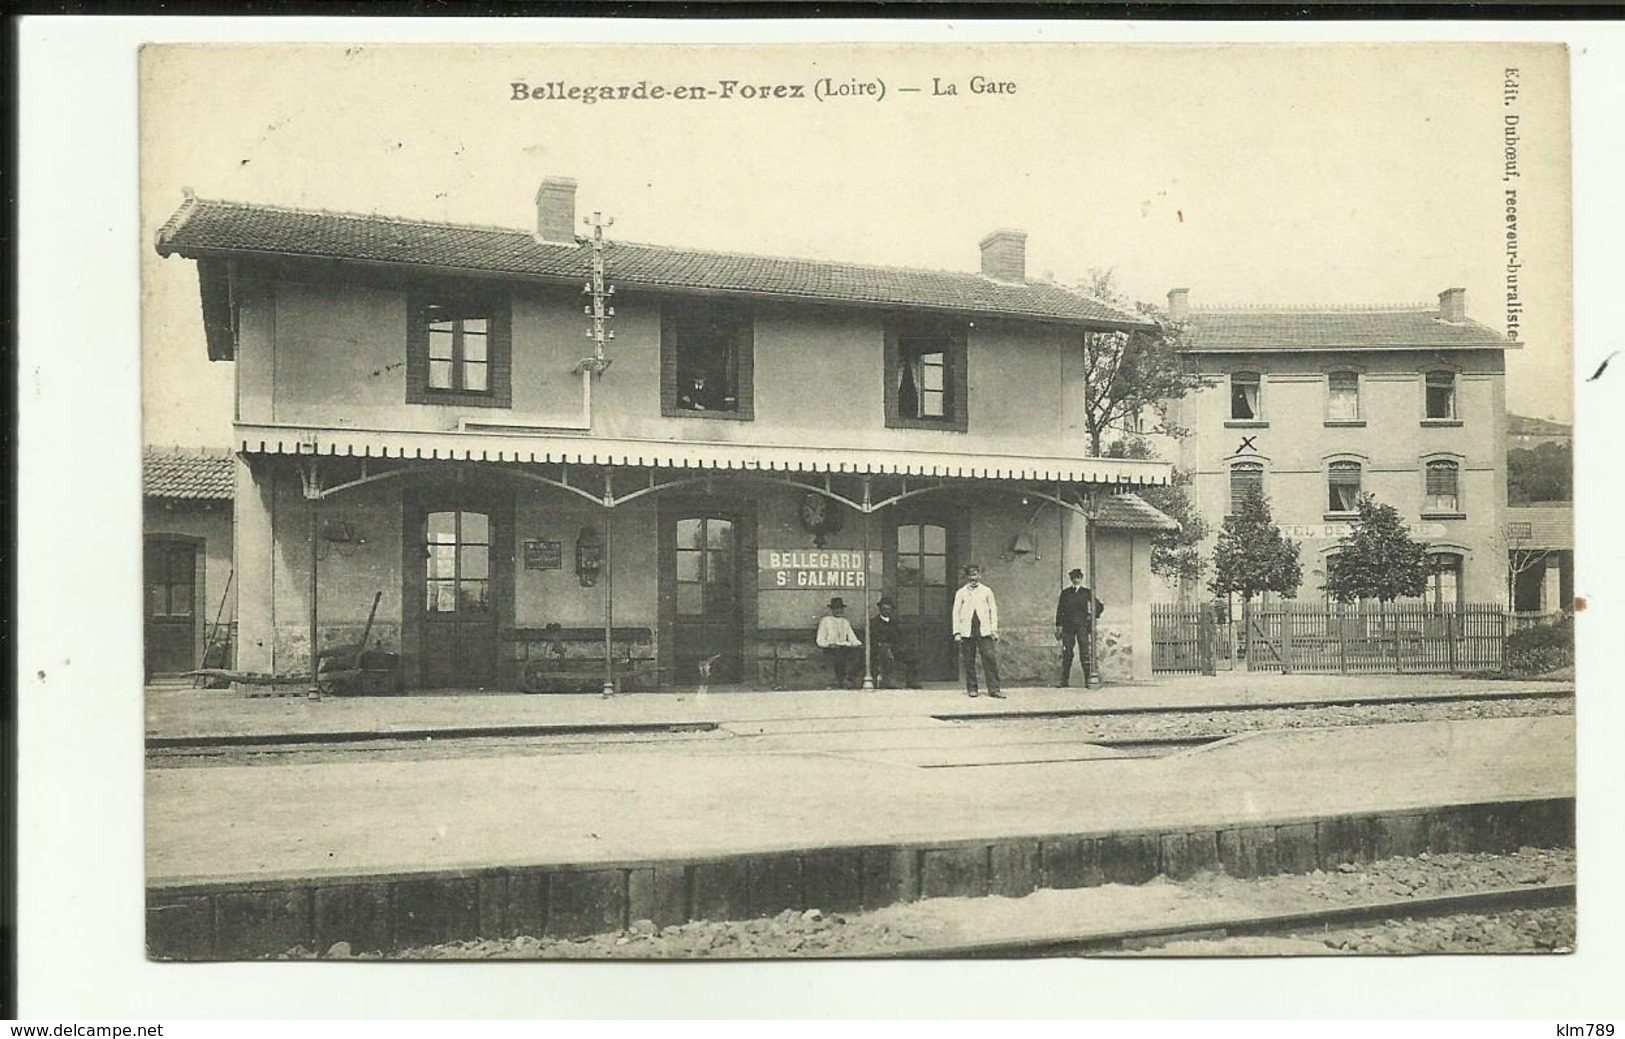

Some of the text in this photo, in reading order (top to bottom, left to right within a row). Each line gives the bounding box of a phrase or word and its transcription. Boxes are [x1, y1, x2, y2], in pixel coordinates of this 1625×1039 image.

[510, 75, 1017, 105] Bellegarde-en-Forez (Loire) La Gare
[1502, 67, 1523, 342] Edit. Dubœuf, receveur-buraliste
[797, 571, 866, 587] GALMIER
